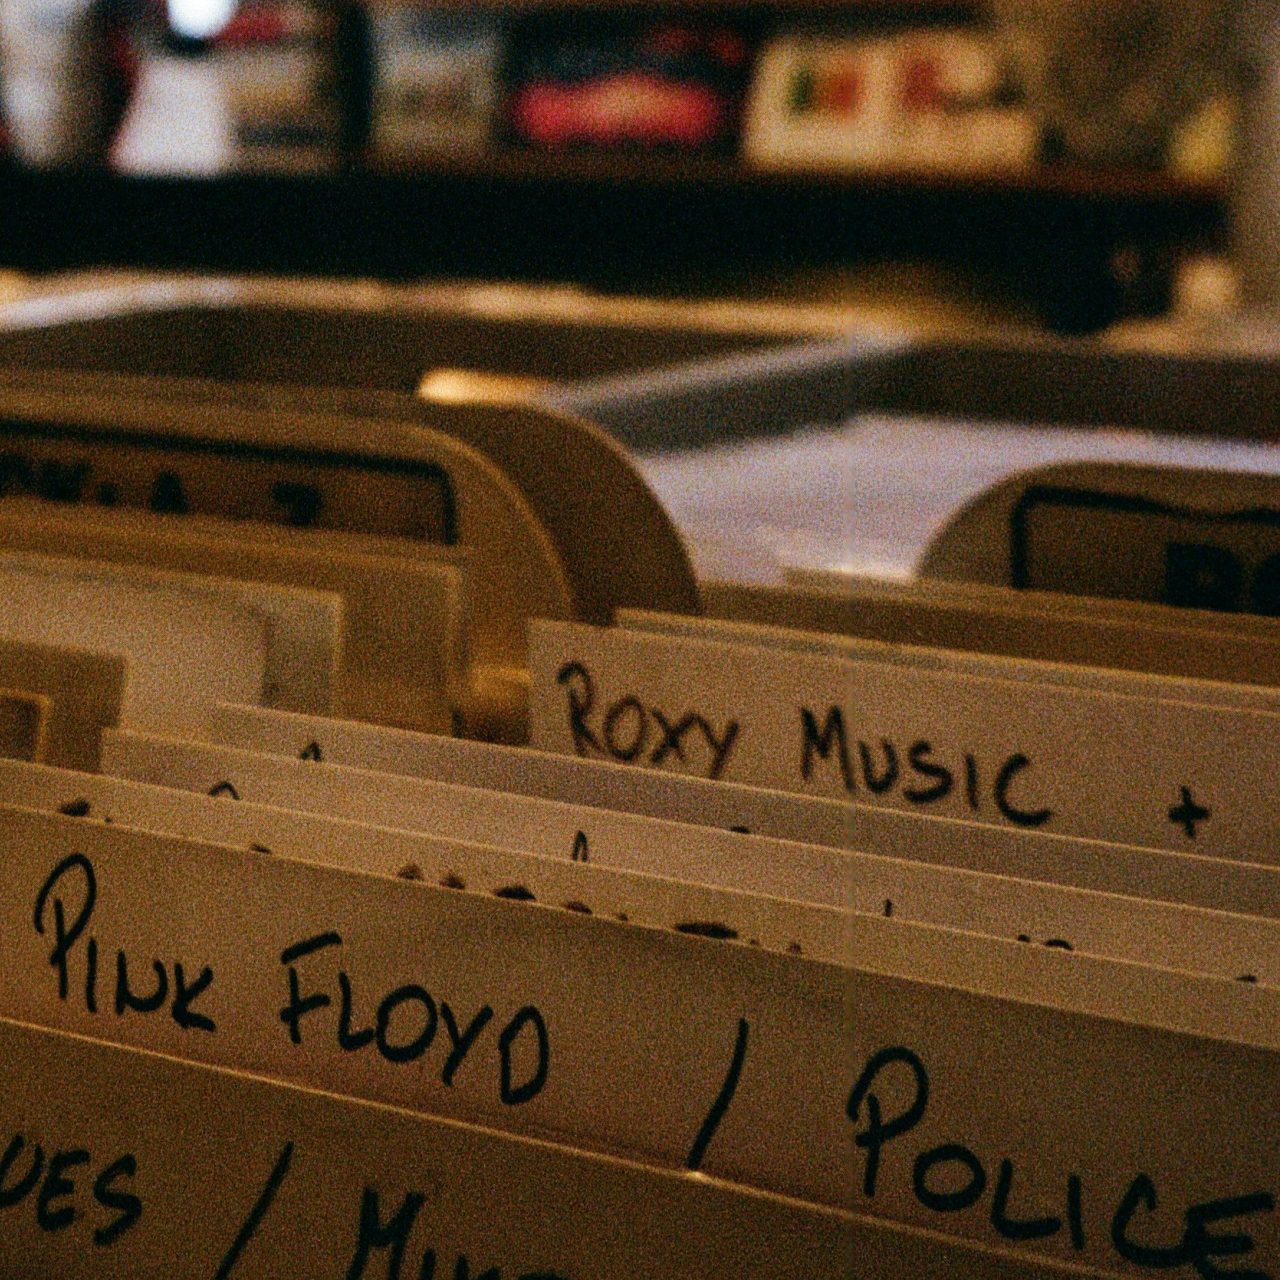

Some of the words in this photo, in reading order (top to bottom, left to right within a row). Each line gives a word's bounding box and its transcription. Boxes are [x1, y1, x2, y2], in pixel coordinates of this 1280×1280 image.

[555, 660, 742, 780] ROXY
[799, 704, 1054, 828] MUSIC
[32, 850, 217, 1034] PINK
[278, 930, 551, 1107] FLOYD
[845, 1044, 1277, 1280] POLICE
